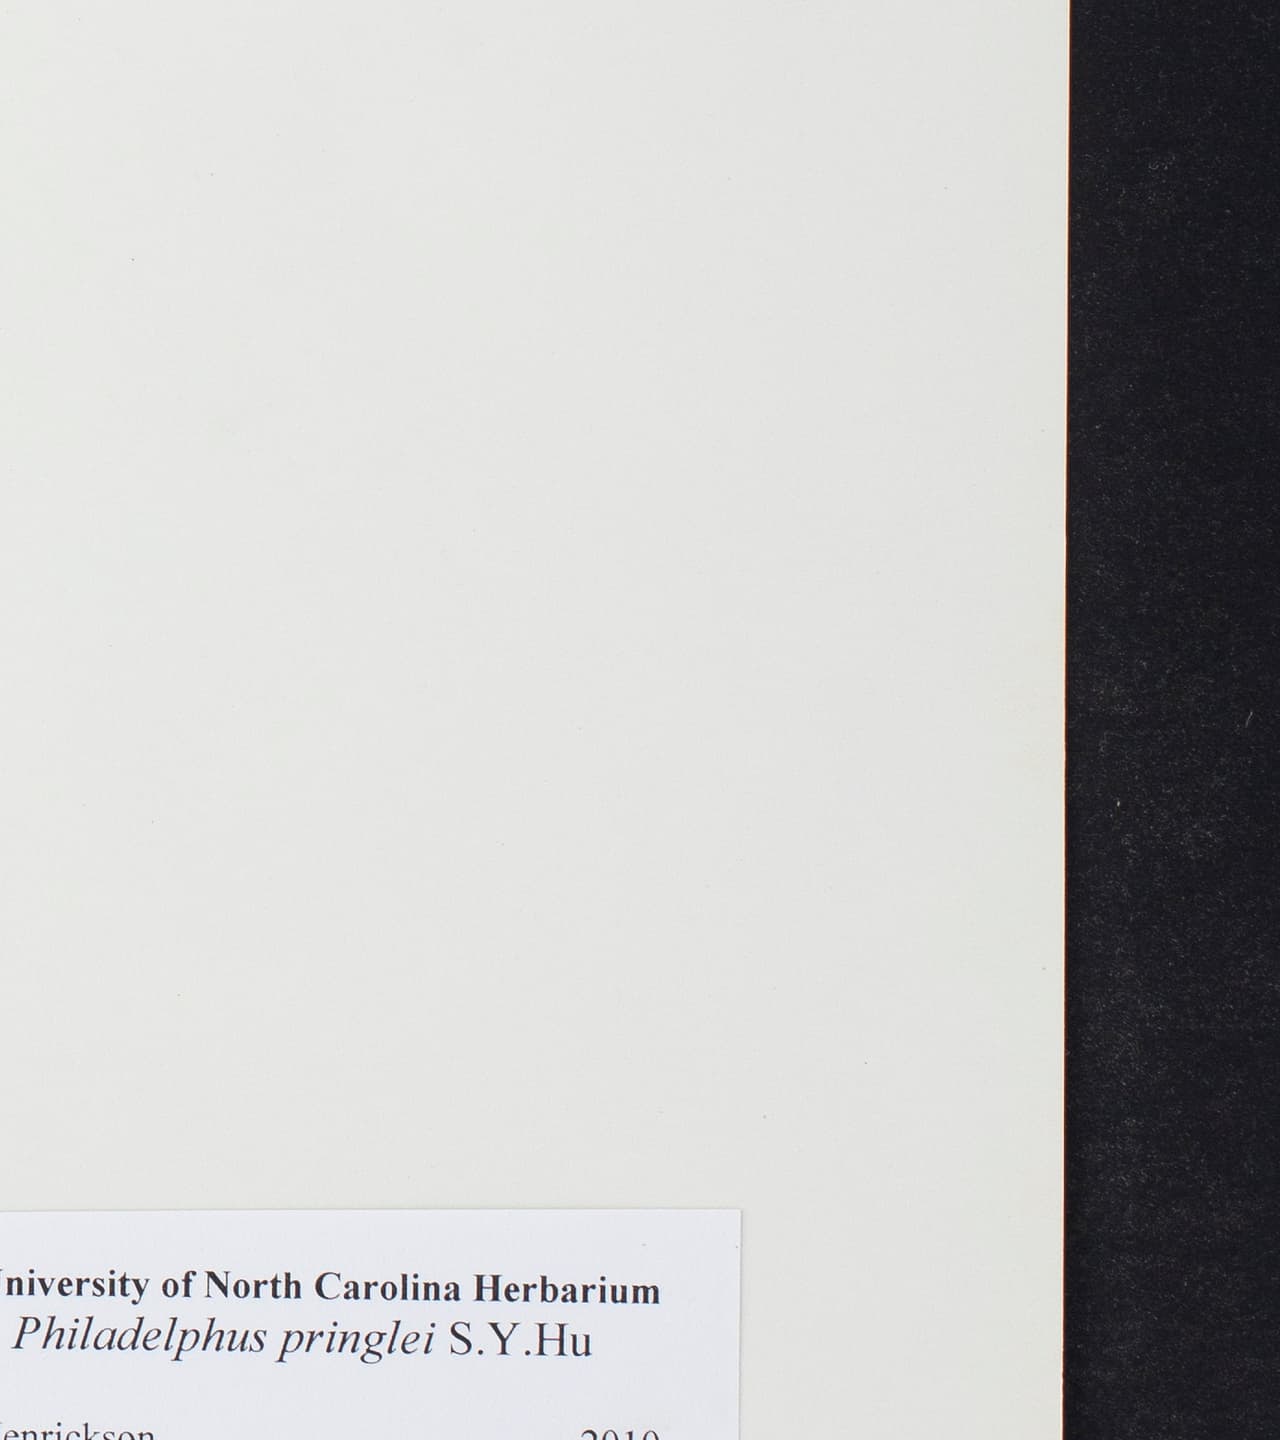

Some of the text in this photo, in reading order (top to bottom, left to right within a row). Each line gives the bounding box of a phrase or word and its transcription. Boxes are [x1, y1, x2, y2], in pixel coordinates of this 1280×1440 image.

[161, 1270, 197, 1298] of
[204, 1270, 302, 1300] North
[314, 1271, 461, 1302] Carolina
[474, 1274, 660, 1305] Herbarium
[11, 1315, 592, 1365] Philadelphus pringlei S.Y.Hu
